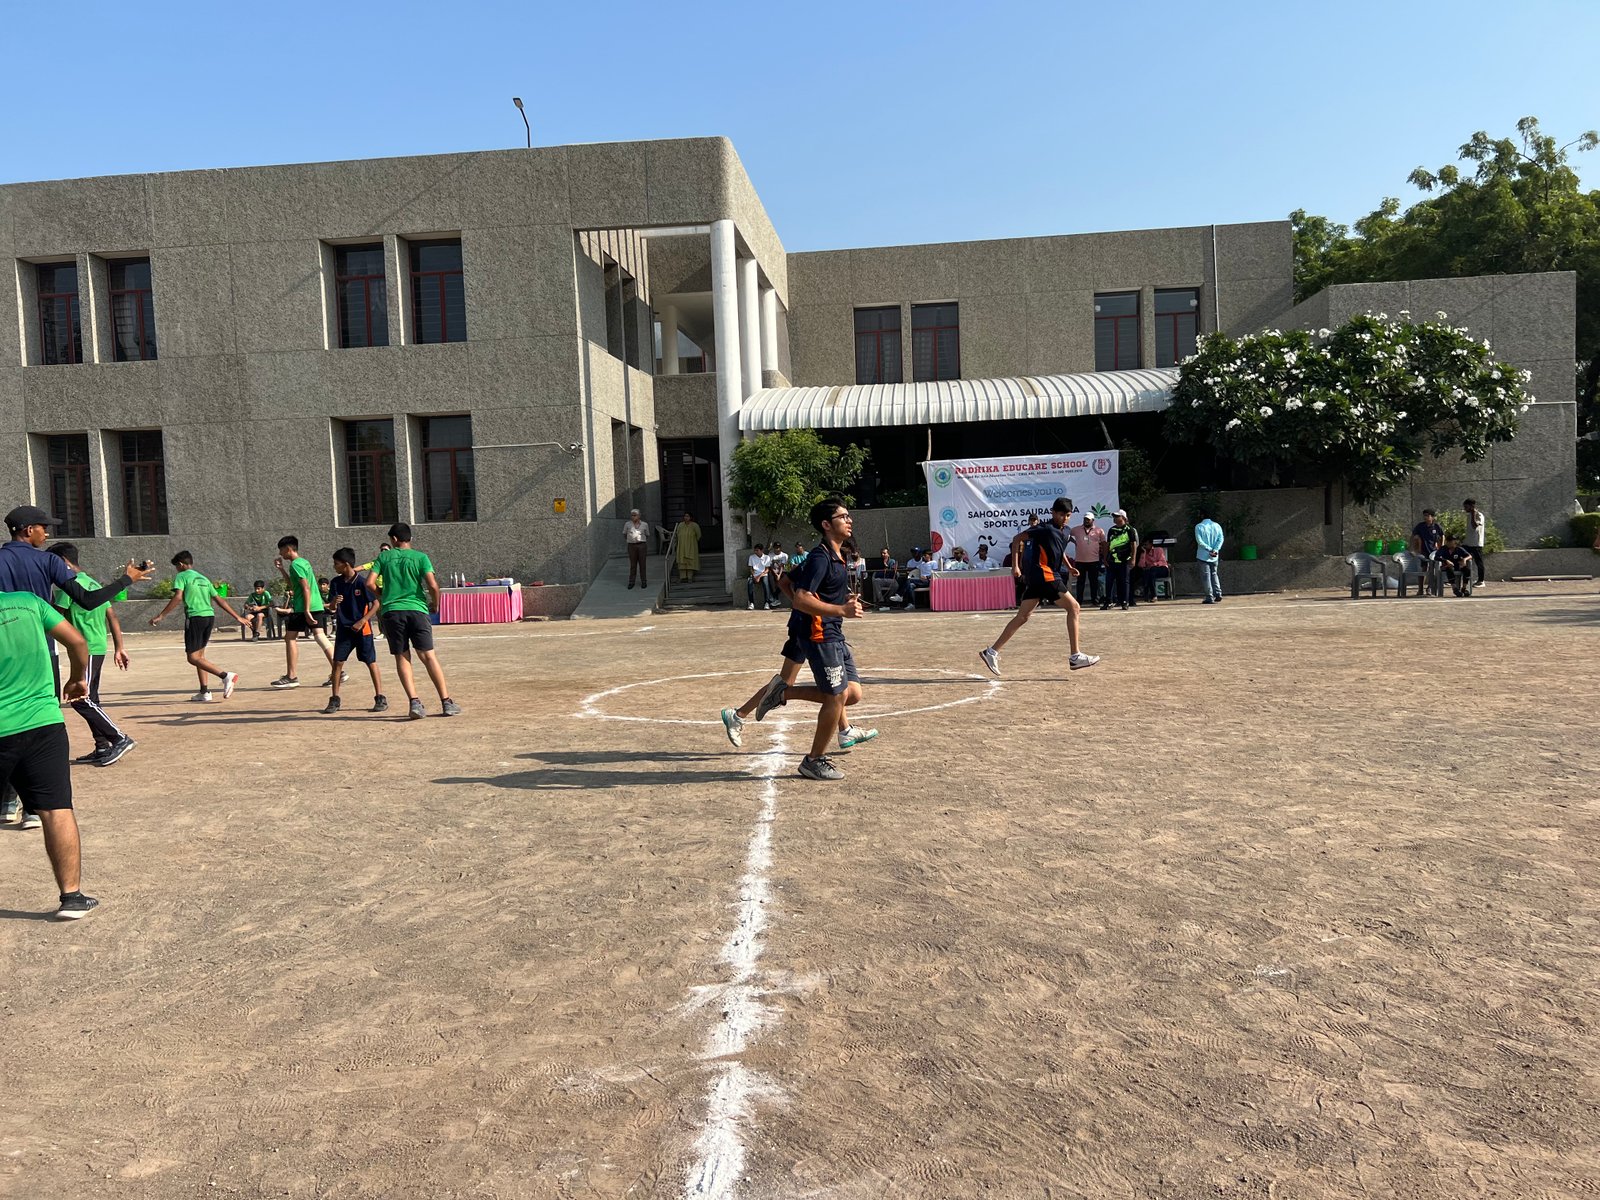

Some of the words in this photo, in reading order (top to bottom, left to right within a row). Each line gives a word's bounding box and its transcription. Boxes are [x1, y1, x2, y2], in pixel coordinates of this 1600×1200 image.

[955, 465, 999, 475] RADHIKA
[1002, 463, 1047, 472] EDUCARE
[1051, 460, 1088, 469] SCHOOL
[984, 487, 1033, 498] Welcomes
[1034, 488, 1052, 498] you
[1053, 487, 1064, 495] to
[968, 509, 1018, 519] SAHODAYA
[1020, 506, 1080, 516] SAURASA
[983, 519, 1019, 529] SPORTS
